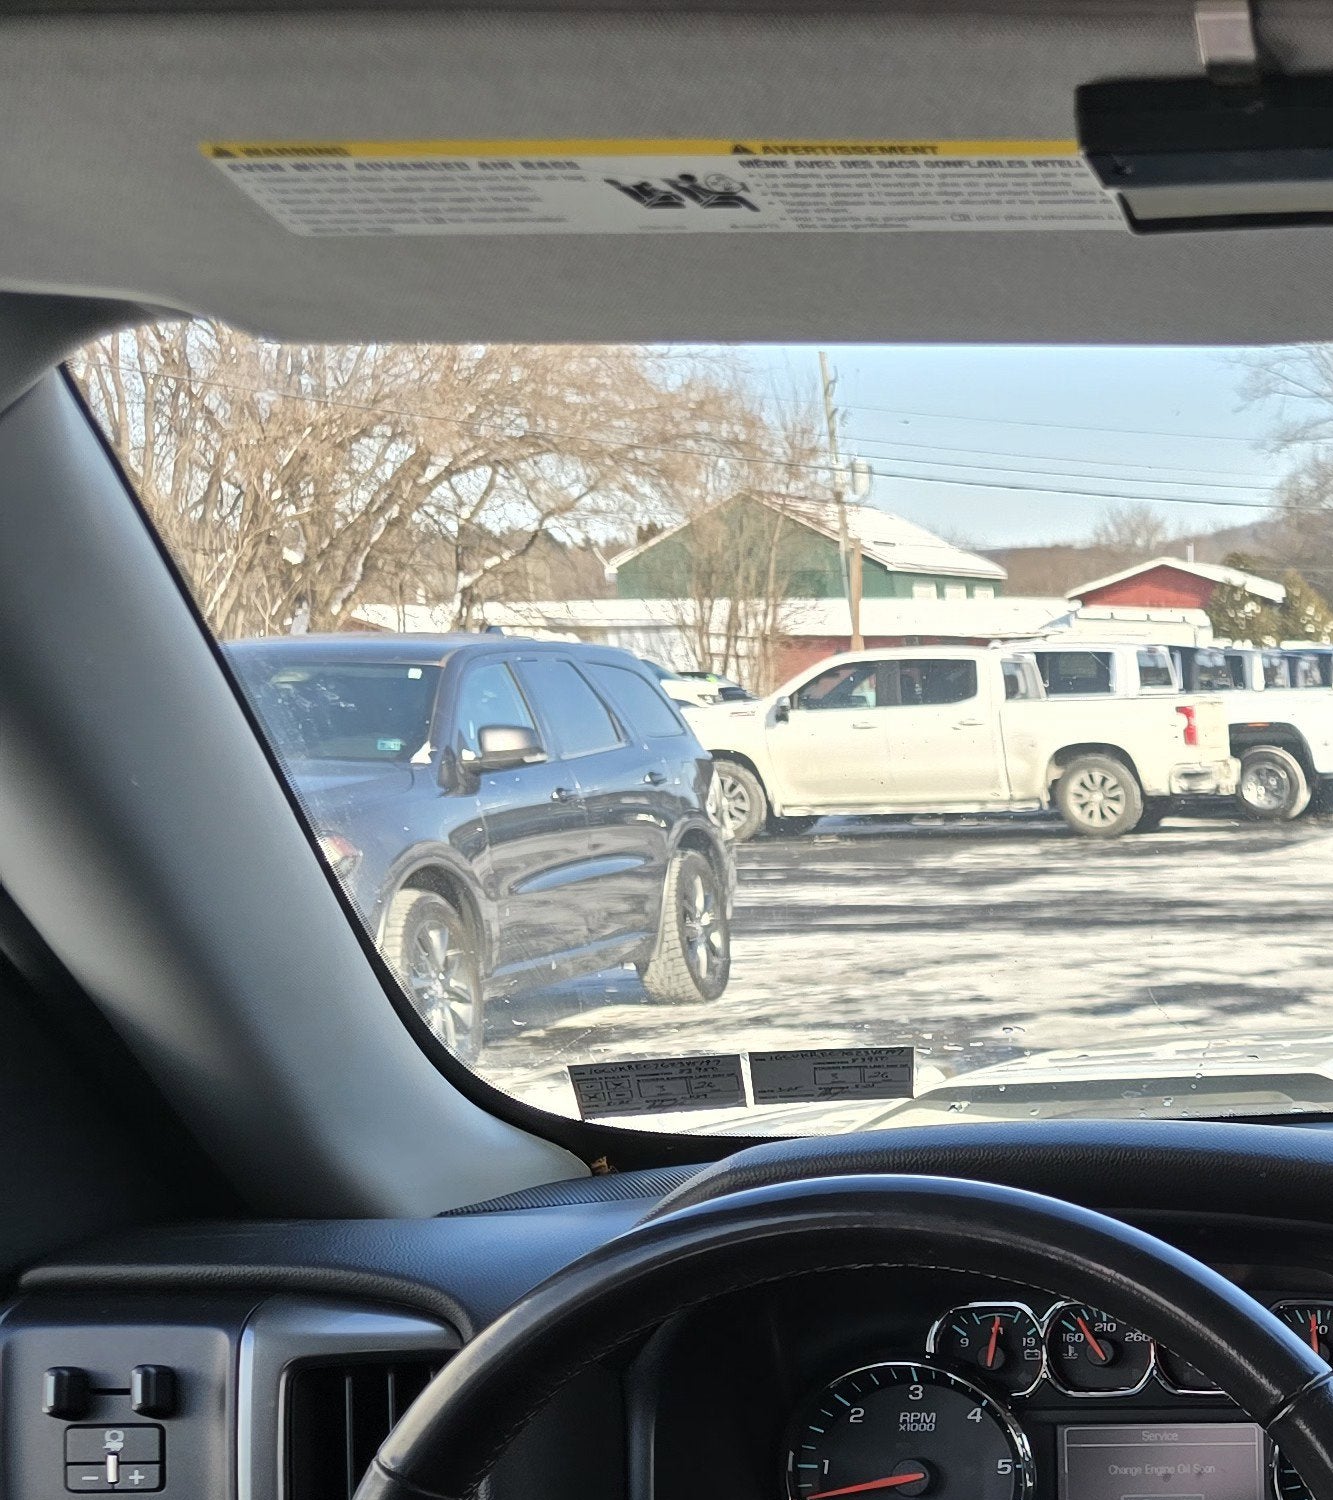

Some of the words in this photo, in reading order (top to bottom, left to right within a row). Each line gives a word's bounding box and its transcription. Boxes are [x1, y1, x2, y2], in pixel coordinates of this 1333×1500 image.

[761, 145, 939, 156] AVERTISSEMENT
[1094, 1323, 1117, 1333] 210
[959, 1338, 970, 1348] 9
[1022, 1337, 1036, 1347] 19
[1062, 1332, 1085, 1344] 160
[1125, 1332, 1151, 1343] 260
[908, 1384, 924, 1401] 3
[849, 1407, 865, 1423] 2
[899, 1412, 937, 1424] RPM
[967, 1407, 983, 1423] 4
[1141, 1430, 1179, 1441] Service
[822, 1458, 831, 1475] 1
[997, 1458, 1013, 1475] 5
[1108, 1464, 1143, 1477] Change
[1144, 1463, 1175, 1477] Engine
[1177, 1463, 1191, 1474] Oil
[1192, 1463, 1216, 1475] Soon
